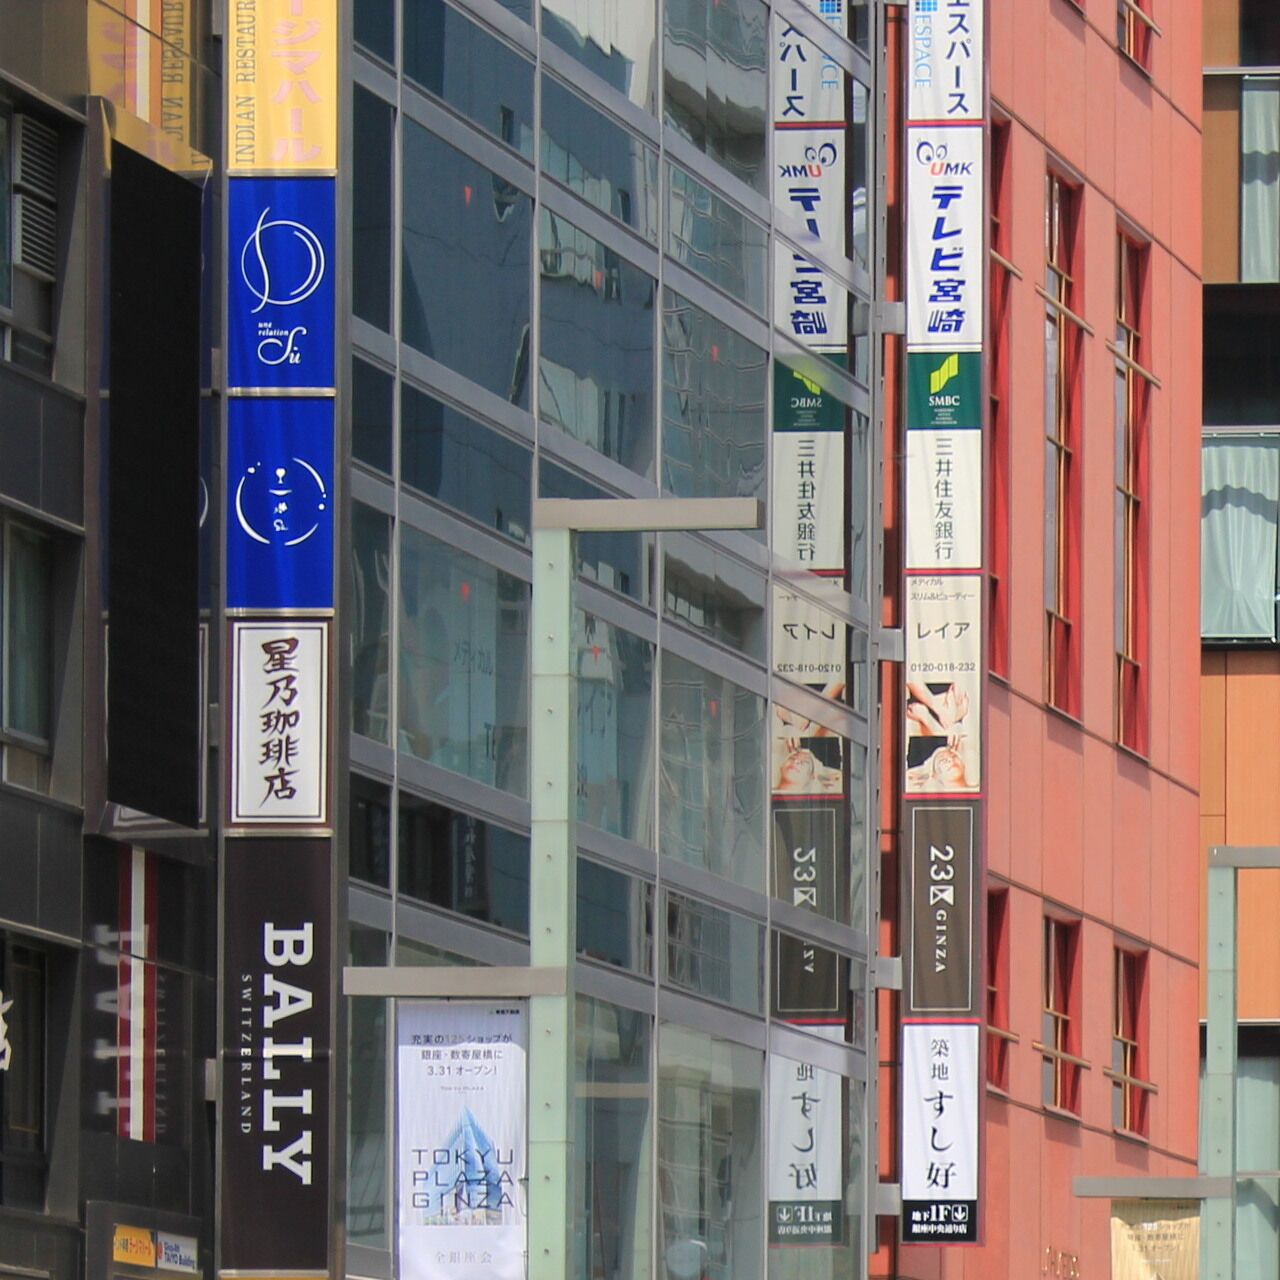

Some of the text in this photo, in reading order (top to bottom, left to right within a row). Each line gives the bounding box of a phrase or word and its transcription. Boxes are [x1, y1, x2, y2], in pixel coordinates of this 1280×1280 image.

[914, 15, 933, 88] ESPACE
[236, 95, 256, 164] INDIAN
[930, 162, 973, 177] UMK
[927, 185, 966, 334] テレビ宮崎
[928, 395, 961, 407] SMBC
[934, 437, 954, 561] 三井住友銀行
[916, 622, 970, 641] レイア
[910, 662, 976, 674] 0120-018-232
[259, 636, 301, 808] 星乃珈琲店
[935, 910, 947, 974] GINZA
[240, 973, 253, 1134] SWITZERLAND
[263, 922, 314, 1185] BALLY
[427, 1065, 452, 1077] 3.31
[923, 1038, 957, 1189] 築地すし好
[411, 1149, 514, 1165] TOKYU
[412, 1171, 515, 1187] PLAZA
[411, 1192, 515, 1209] GINZA
